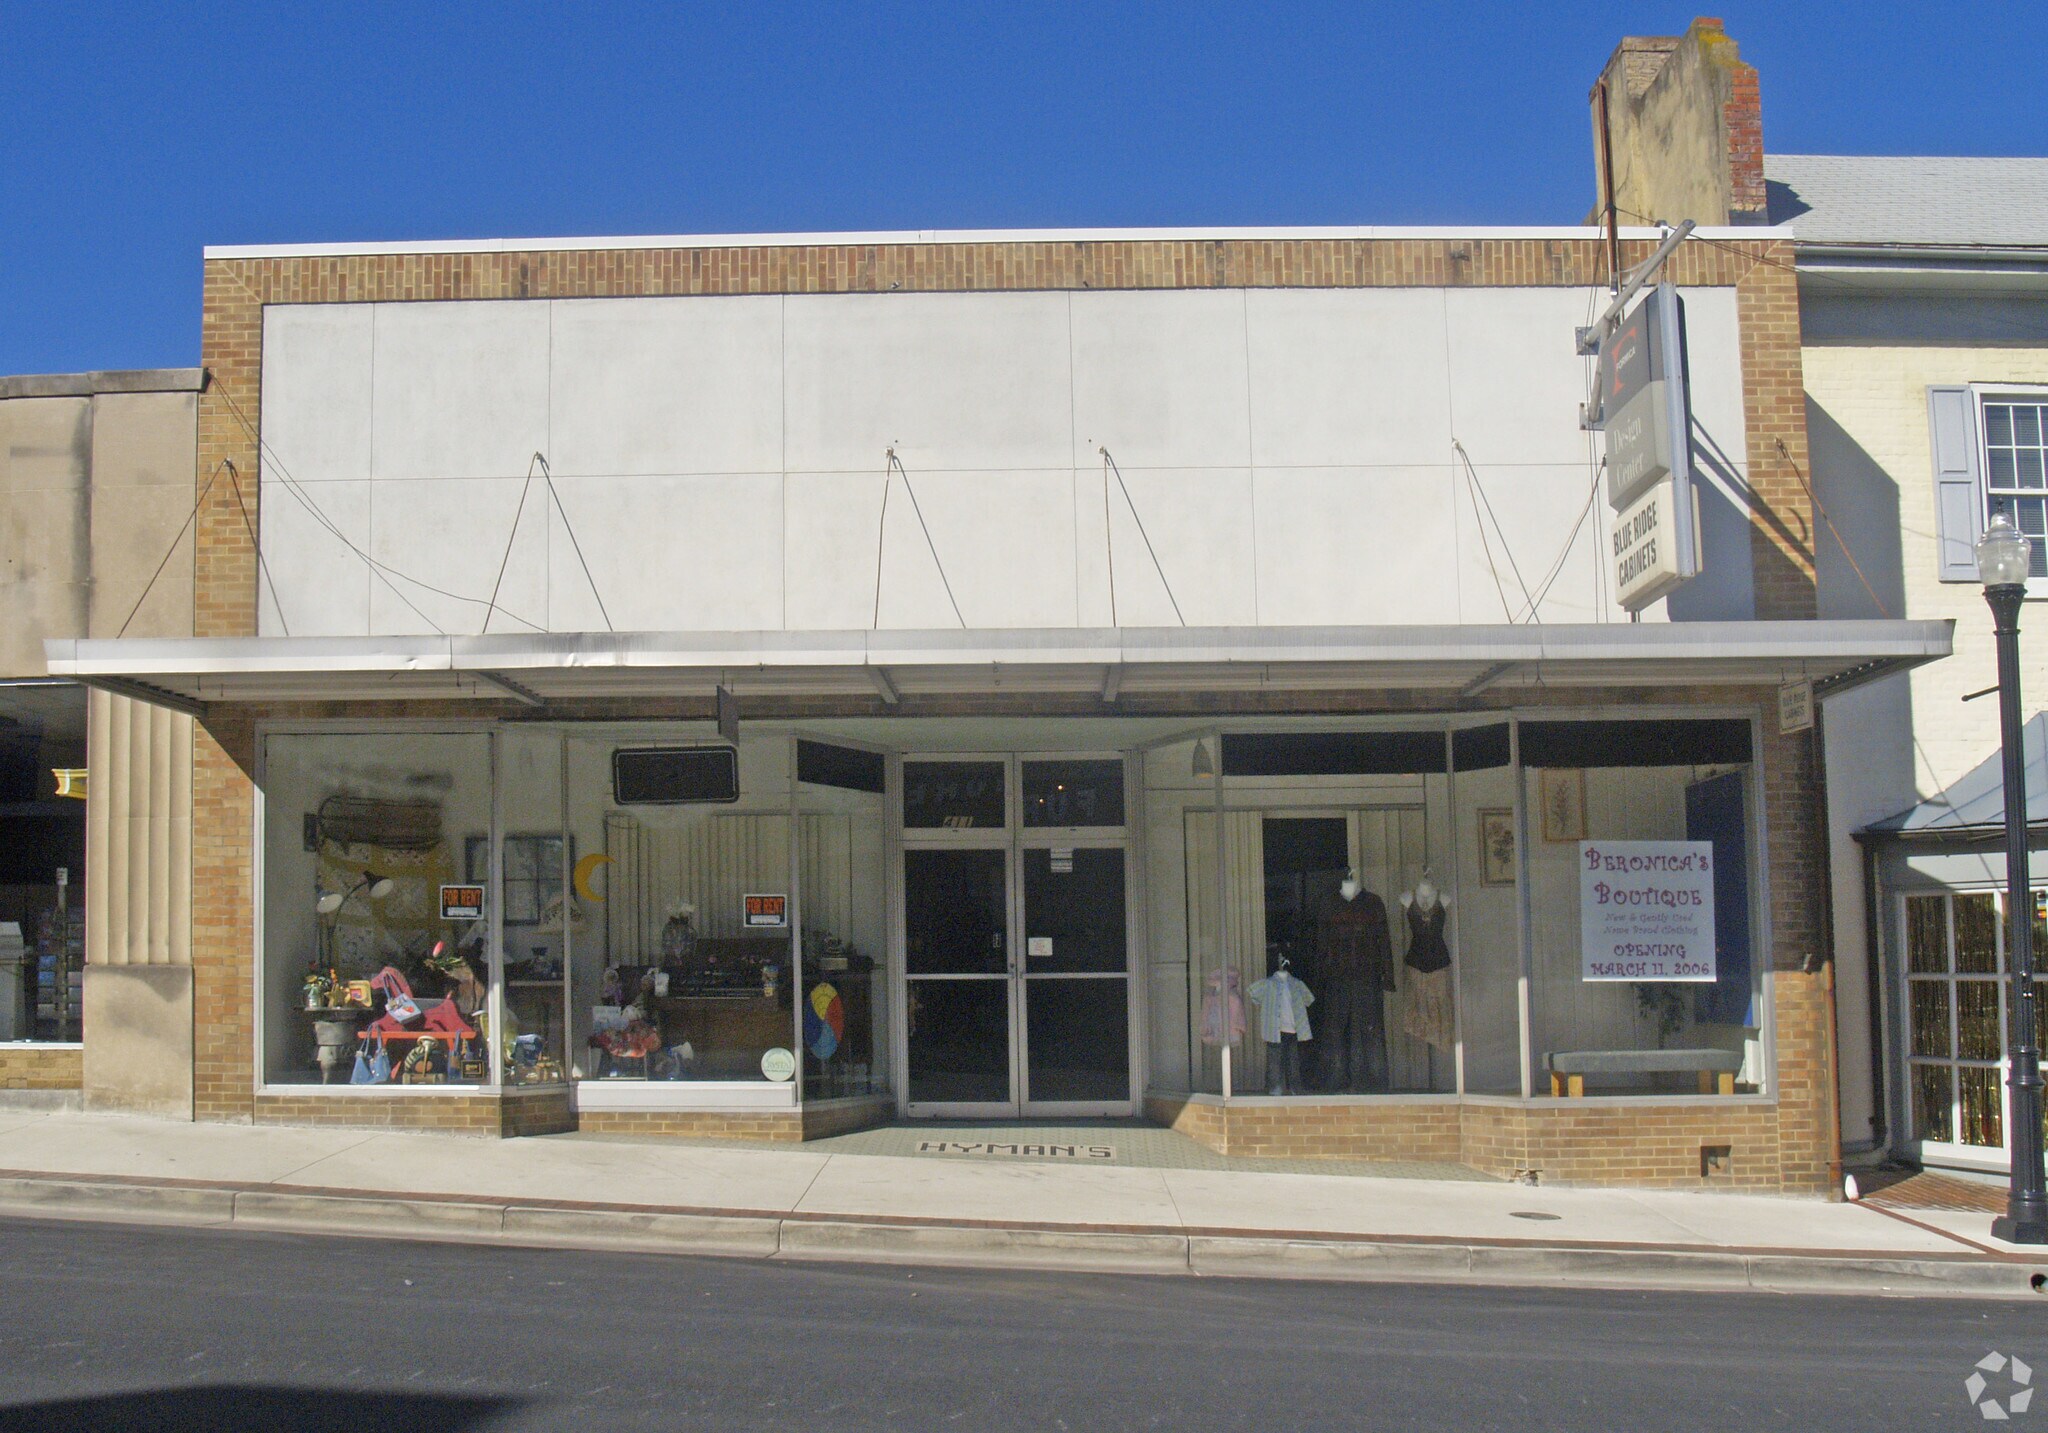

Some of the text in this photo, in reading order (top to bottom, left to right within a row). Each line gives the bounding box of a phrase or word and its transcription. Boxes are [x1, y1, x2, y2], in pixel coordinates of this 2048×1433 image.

[1616, 346, 1636, 371] FORMICA
[1613, 416, 1642, 454] Design
[1616, 452, 1643, 488] Center
[1613, 501, 1657, 557] BLUE RIDGE
[1618, 537, 1657, 587] CABINETS
[1585, 847, 1709, 873] BERONICA'S
[444, 889, 482, 907] FOR RENT
[747, 897, 784, 915] FOR RENT
[1594, 881, 1702, 908] BOUTIQUE
[1613, 943, 1686, 959] OPENING
[1590, 962, 1646, 976] MARCH
[1674, 962, 1709, 975] 2006
[920, 1142, 1111, 1158] HYMAN'S
